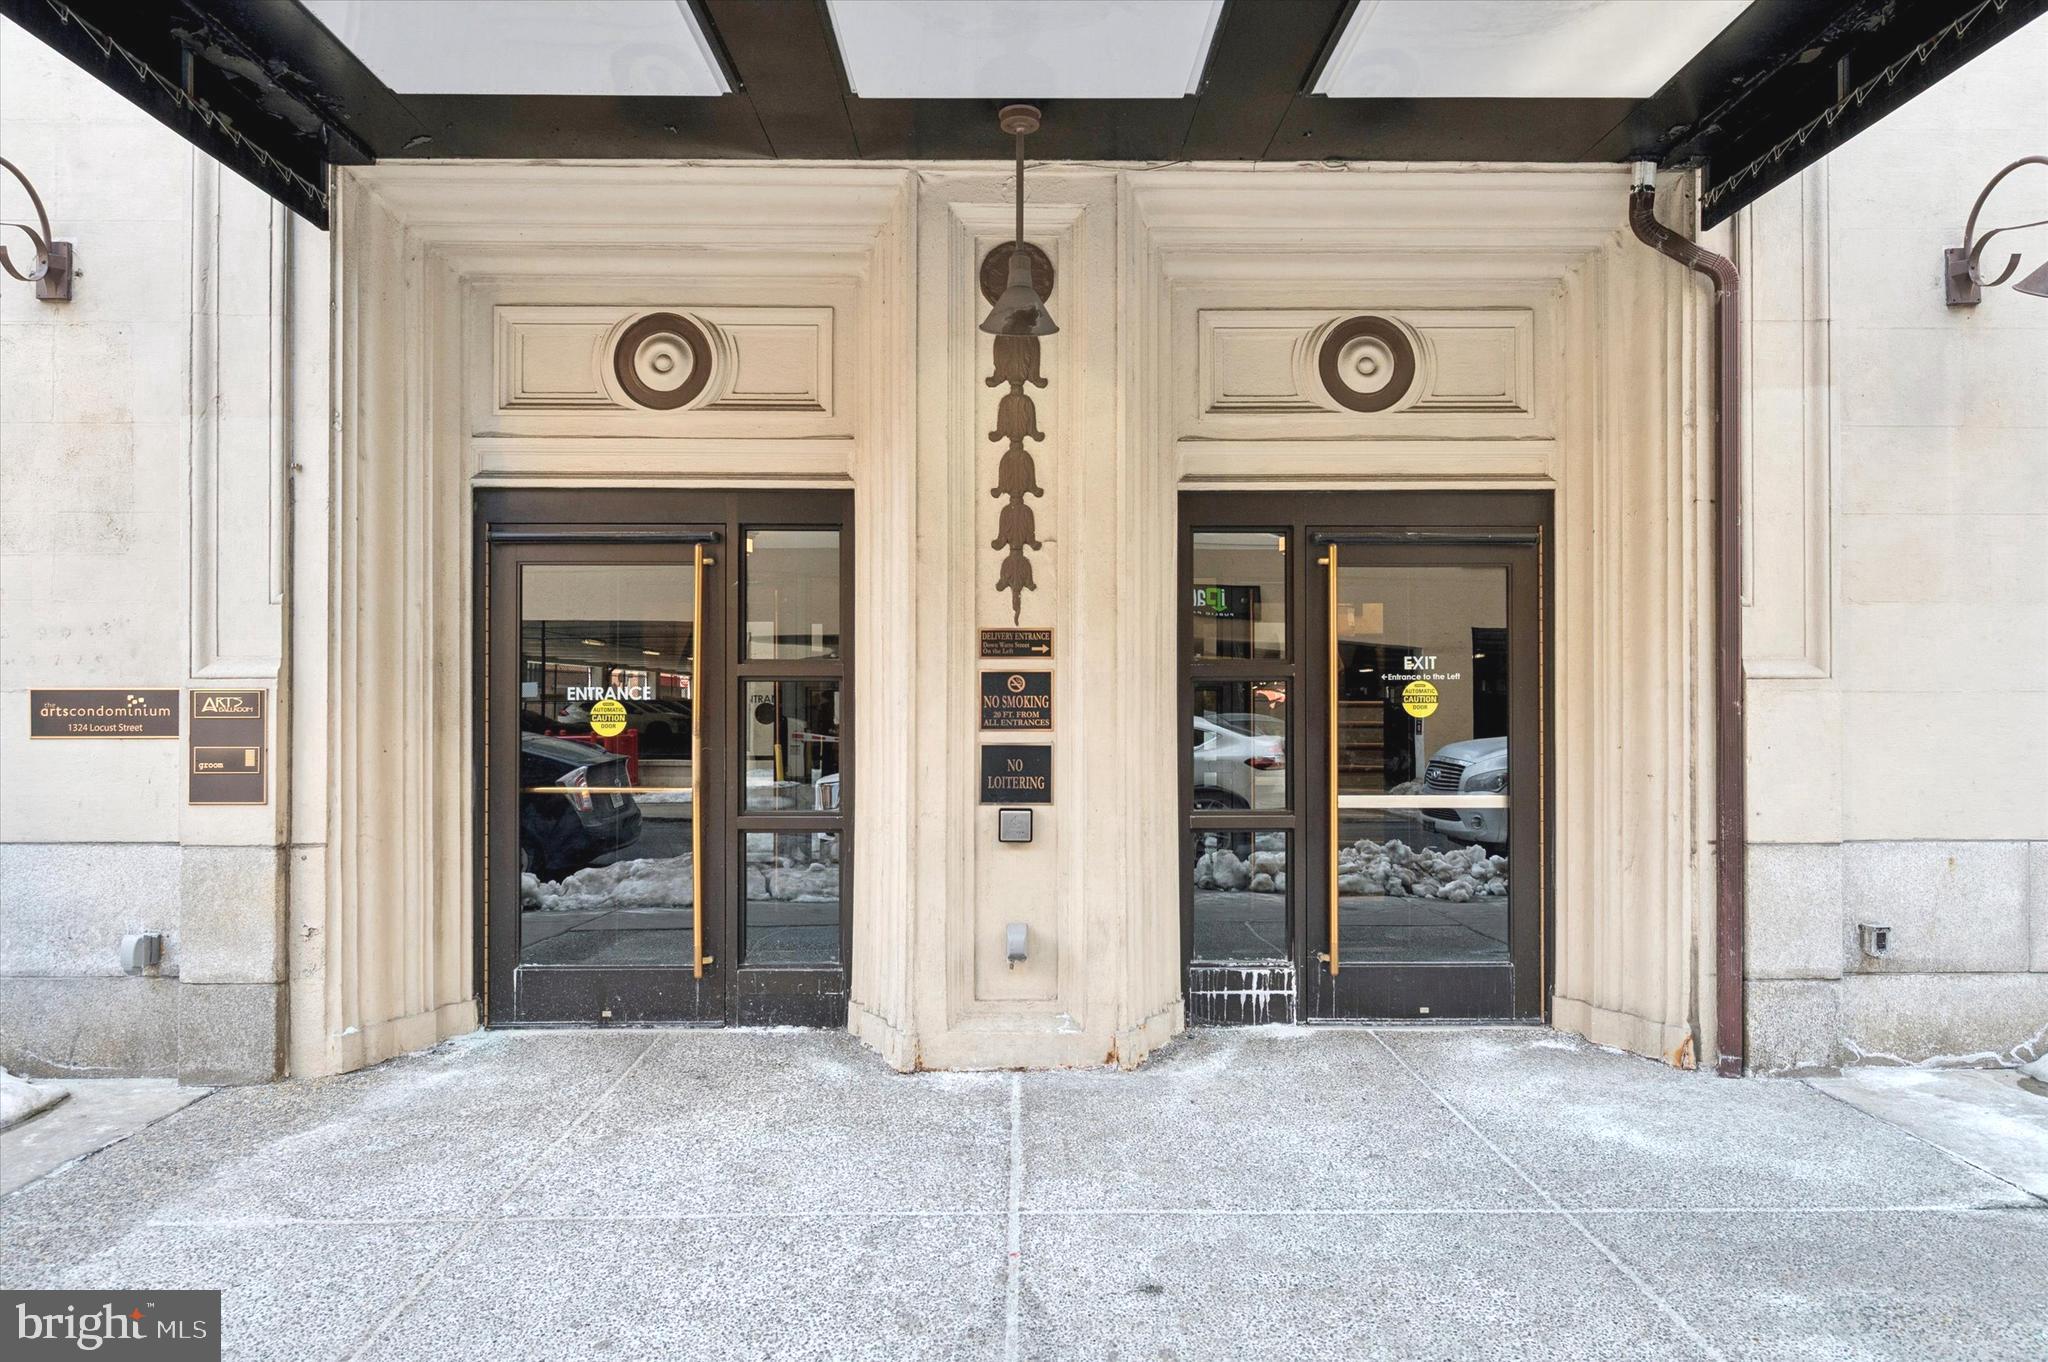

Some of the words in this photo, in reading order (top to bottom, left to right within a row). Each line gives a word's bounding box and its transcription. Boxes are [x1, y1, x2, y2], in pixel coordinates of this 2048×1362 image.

[982, 631, 1013, 640] DELIVERY
[1015, 631, 1050, 640] ENTRANCE
[1404, 656, 1437, 670] EXIT
[1433, 672, 1445, 680] the
[1447, 672, 1460, 680] Left
[567, 686, 651, 700] ENTRANCE
[983, 695, 1000, 708] NO
[1002, 695, 1049, 708] SMOKING
[40, 705, 171, 717] artscondominium
[591, 714, 626, 722] CAUTION
[68, 723, 88, 732] 1324
[89, 723, 117, 732] Locust
[118, 723, 144, 732] Street
[198, 762, 224, 770] groom
[1007, 758, 1024, 772] NO
[987, 776, 1045, 790] LOITERING
